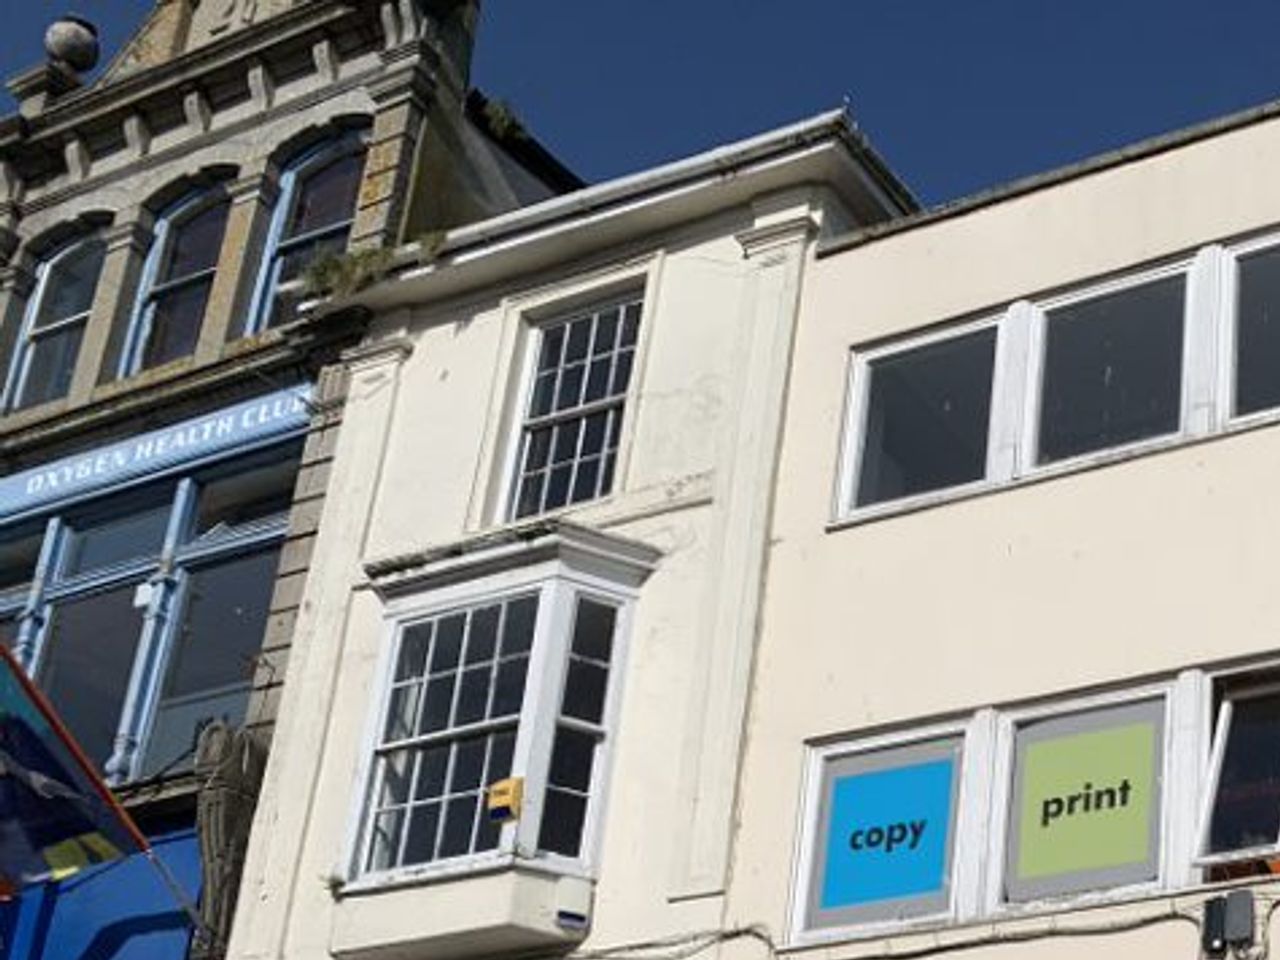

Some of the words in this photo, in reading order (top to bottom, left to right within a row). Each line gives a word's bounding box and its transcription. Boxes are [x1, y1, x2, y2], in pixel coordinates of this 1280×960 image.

[26, 450, 126, 494] OXYGEN
[135, 419, 236, 460] HEALTH
[1040, 779, 1132, 827] print
[850, 818, 928, 853] copy
